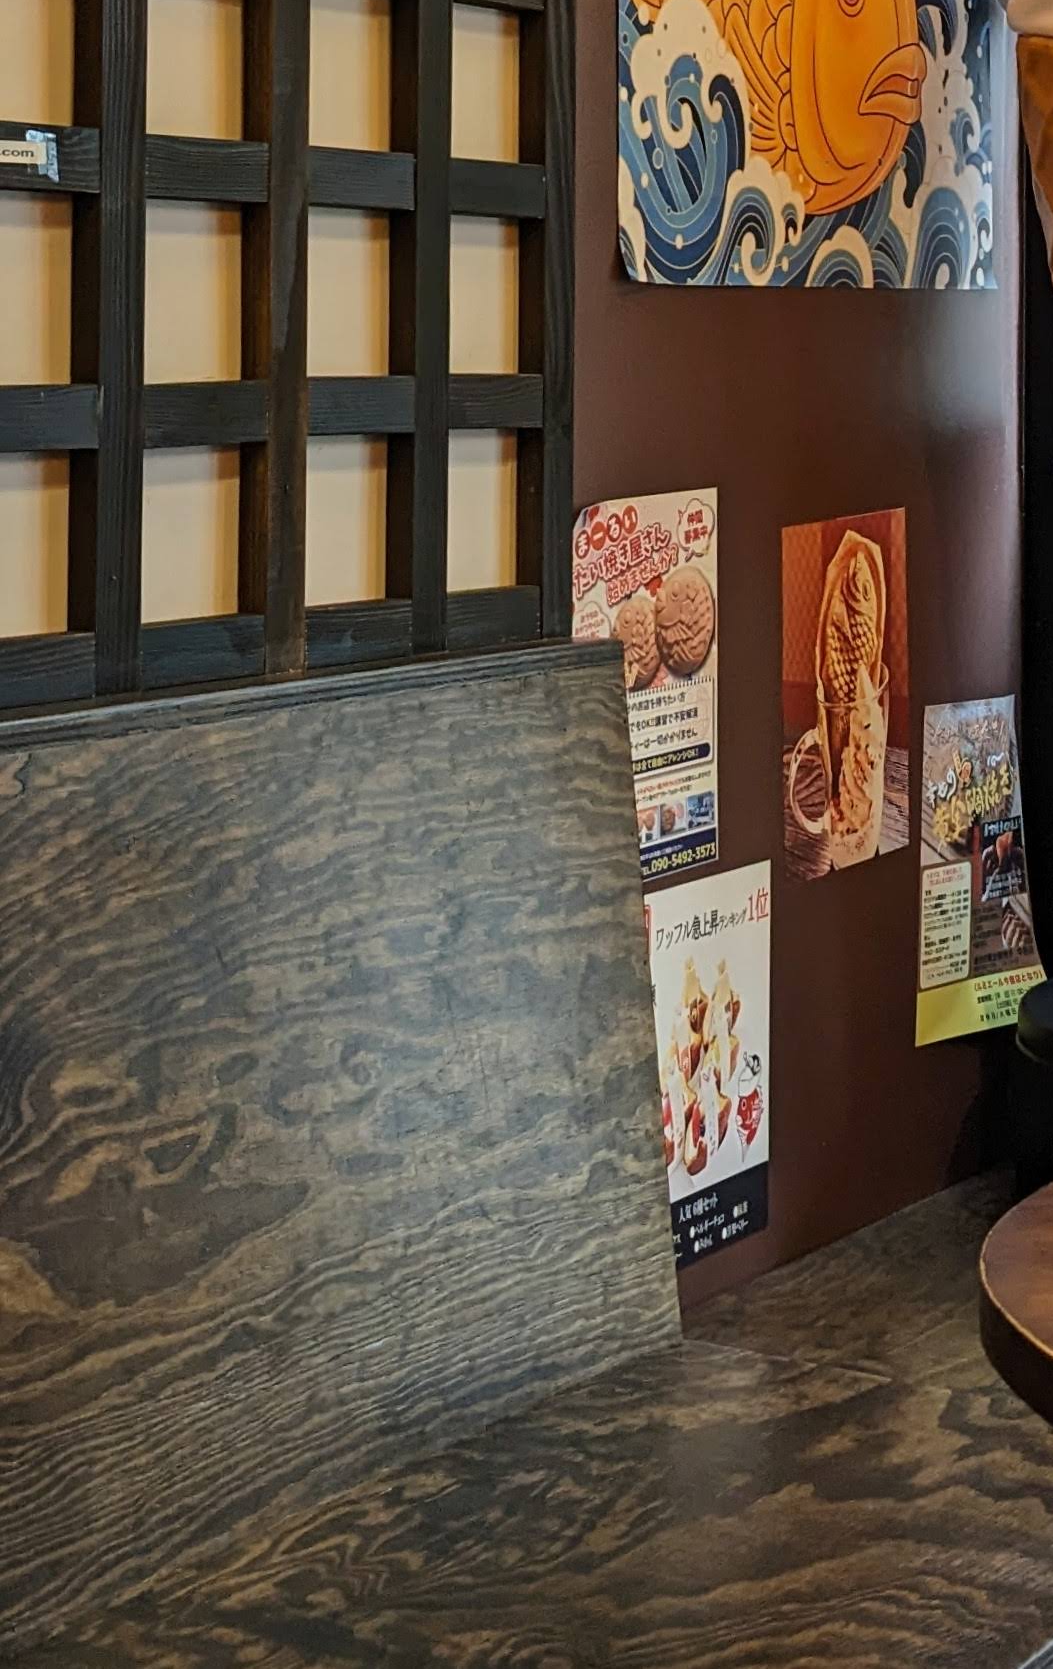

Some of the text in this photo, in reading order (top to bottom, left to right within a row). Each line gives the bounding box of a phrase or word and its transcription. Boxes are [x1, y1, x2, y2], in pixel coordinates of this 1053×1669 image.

[572, 524, 670, 598] たい焼き屋さん
